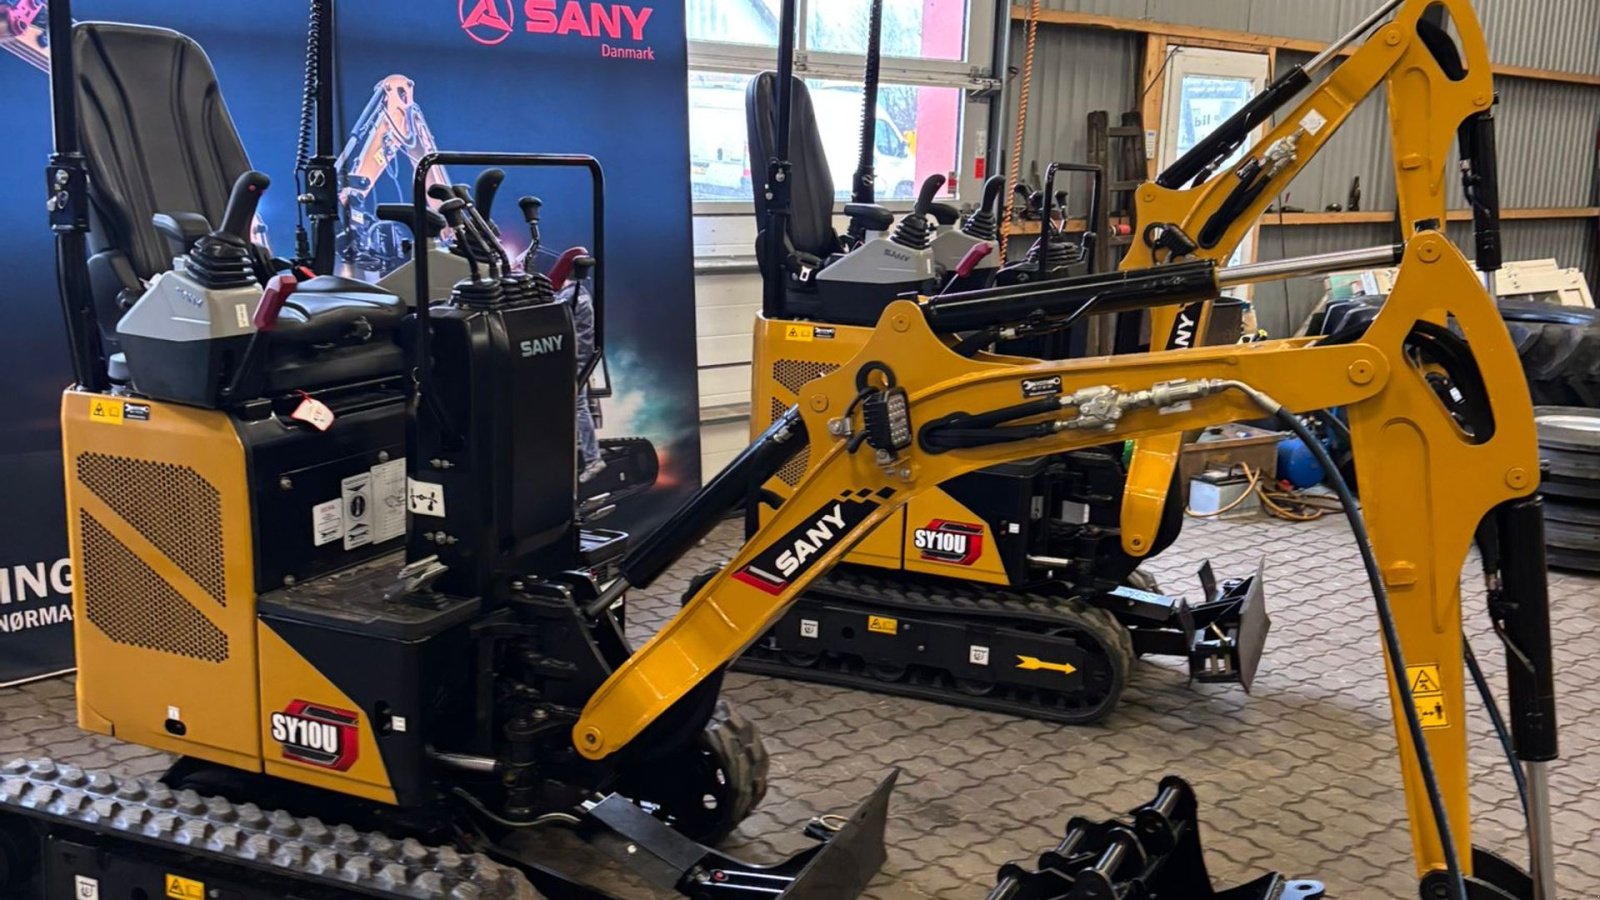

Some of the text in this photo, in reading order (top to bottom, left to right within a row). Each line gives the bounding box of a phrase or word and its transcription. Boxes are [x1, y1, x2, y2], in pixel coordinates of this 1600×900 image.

[524, 0, 653, 41] SANY
[601, 44, 655, 60] Danmark
[520, 334, 563, 357] SANY
[775, 503, 846, 577] SANY
[914, 529, 966, 554] SY10U
[272, 713, 338, 753] SY10U
